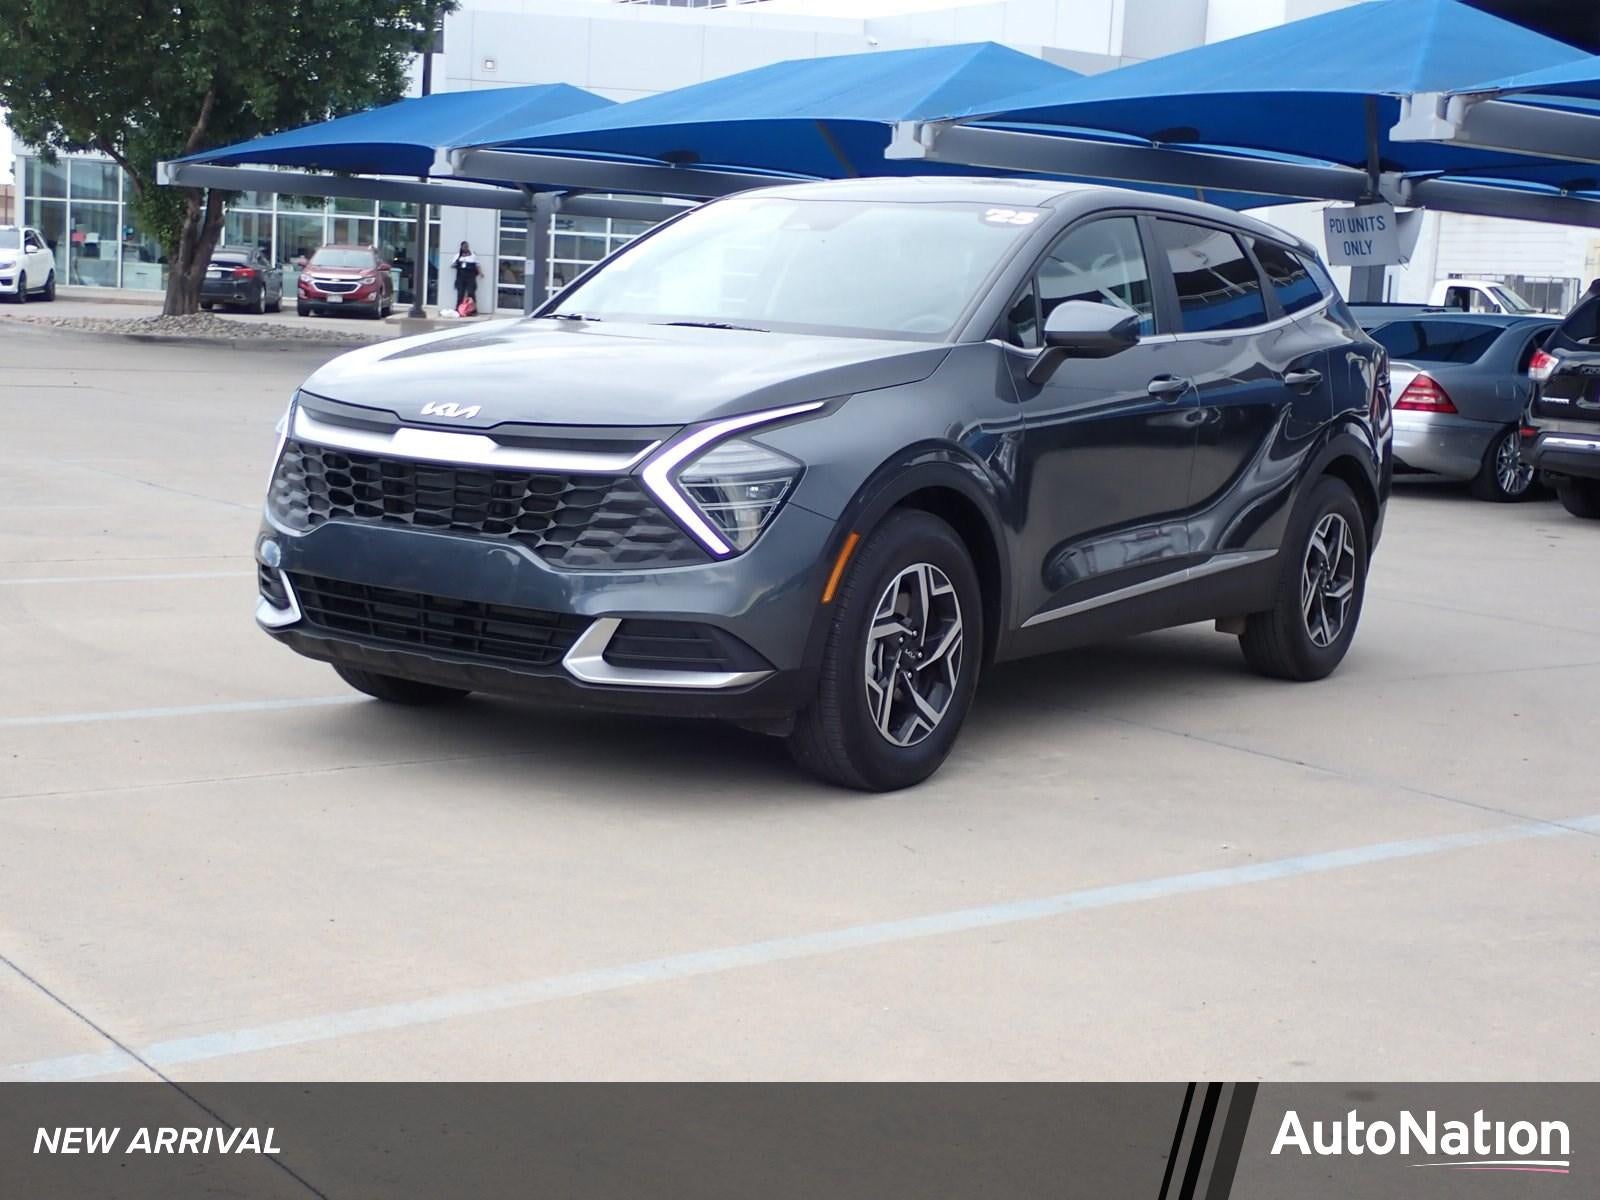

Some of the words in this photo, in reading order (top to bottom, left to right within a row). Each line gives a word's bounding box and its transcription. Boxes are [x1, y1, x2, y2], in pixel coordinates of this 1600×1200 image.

[1329, 218, 1346, 234] PDI
[1348, 215, 1386, 233] UNITS
[1343, 240, 1373, 256] ONLY
